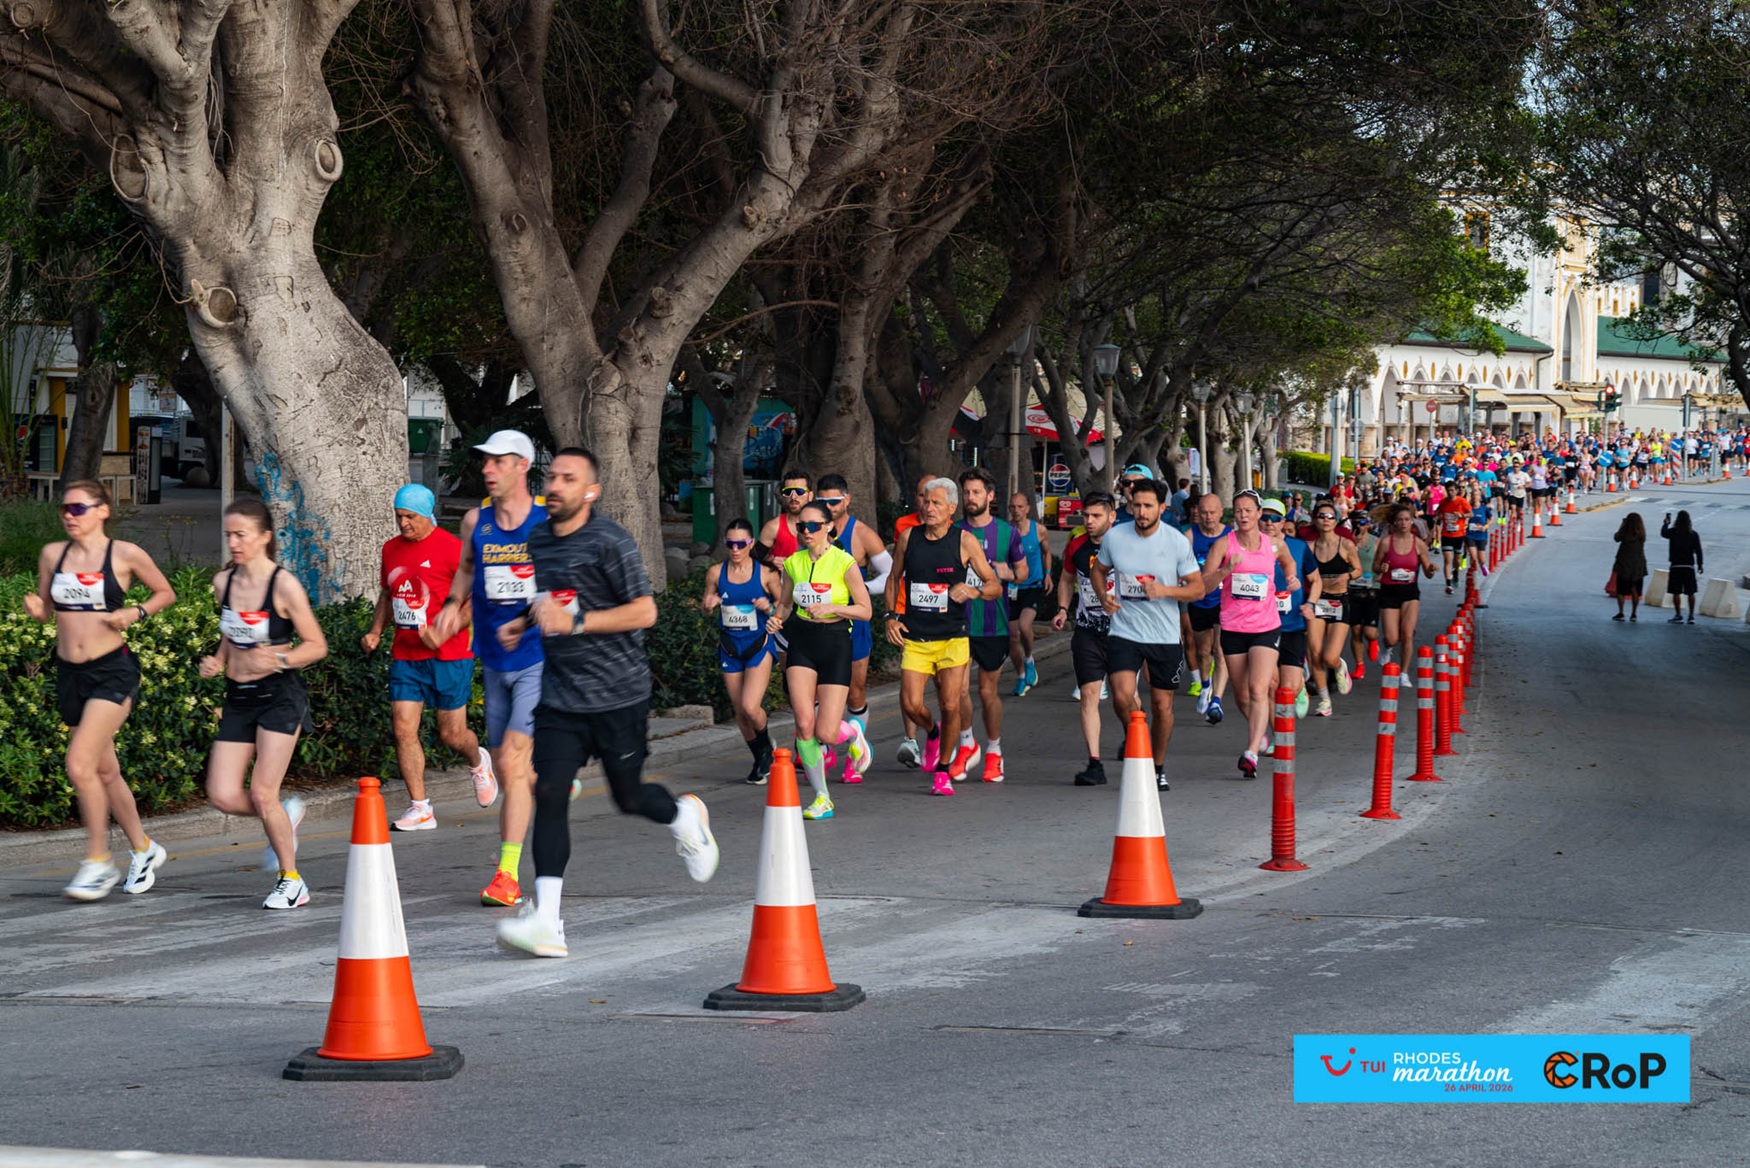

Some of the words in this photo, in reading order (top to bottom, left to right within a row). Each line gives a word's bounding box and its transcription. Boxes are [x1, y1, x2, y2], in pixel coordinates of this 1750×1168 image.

[483, 542, 528, 554] EXMOUT
[1127, 585, 1144, 594] 270
[1240, 583, 1260, 593] 4043
[801, 594, 822, 604] 2115
[918, 594, 939, 604] 2497
[397, 610, 417, 621] 2476
